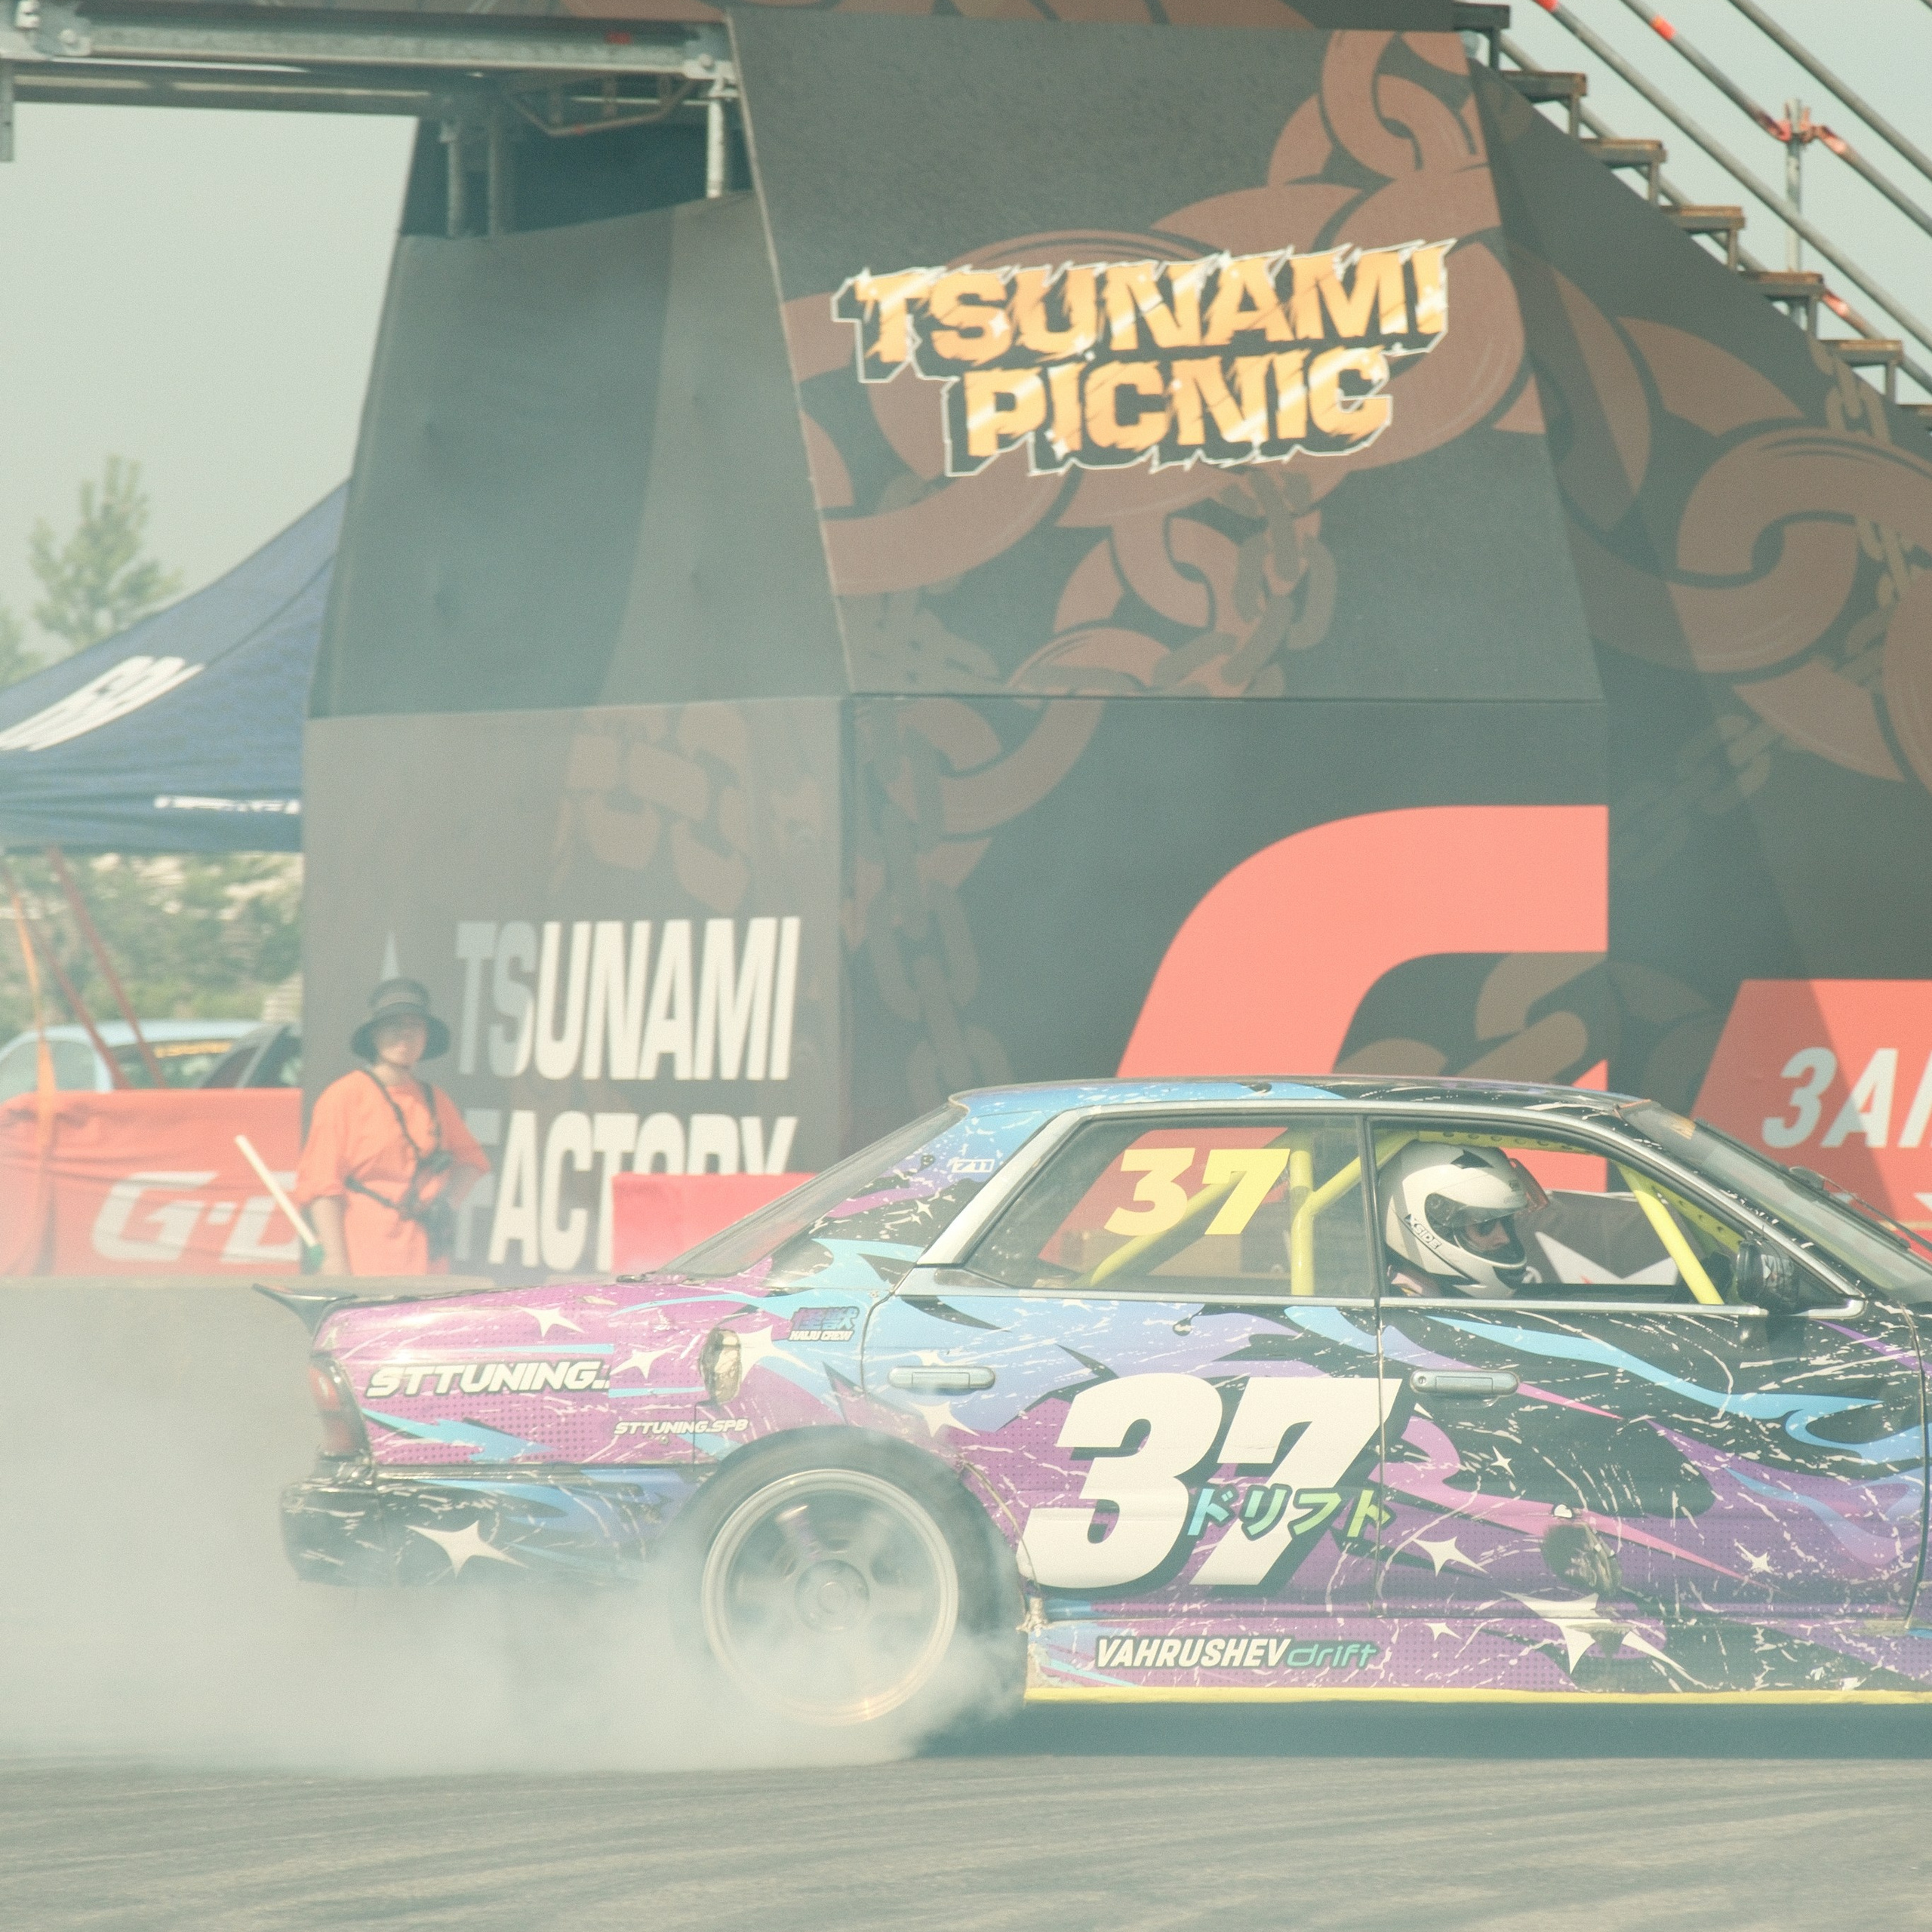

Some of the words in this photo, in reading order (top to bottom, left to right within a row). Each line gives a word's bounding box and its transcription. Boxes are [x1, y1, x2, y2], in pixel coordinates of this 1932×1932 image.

[844, 242, 1454, 370] TSUNAMI
[955, 346, 1392, 468] PICNIC
[456, 916, 800, 1081] TSUNAMI
[1104, 1147, 1291, 1237] 37
[366, 1361, 610, 1397] STTUNING.
[614, 1420, 748, 1434] STTUNING.SPB
[1016, 1373, 1402, 1588] 37
[1187, 1487, 1392, 1540] ドリフト
